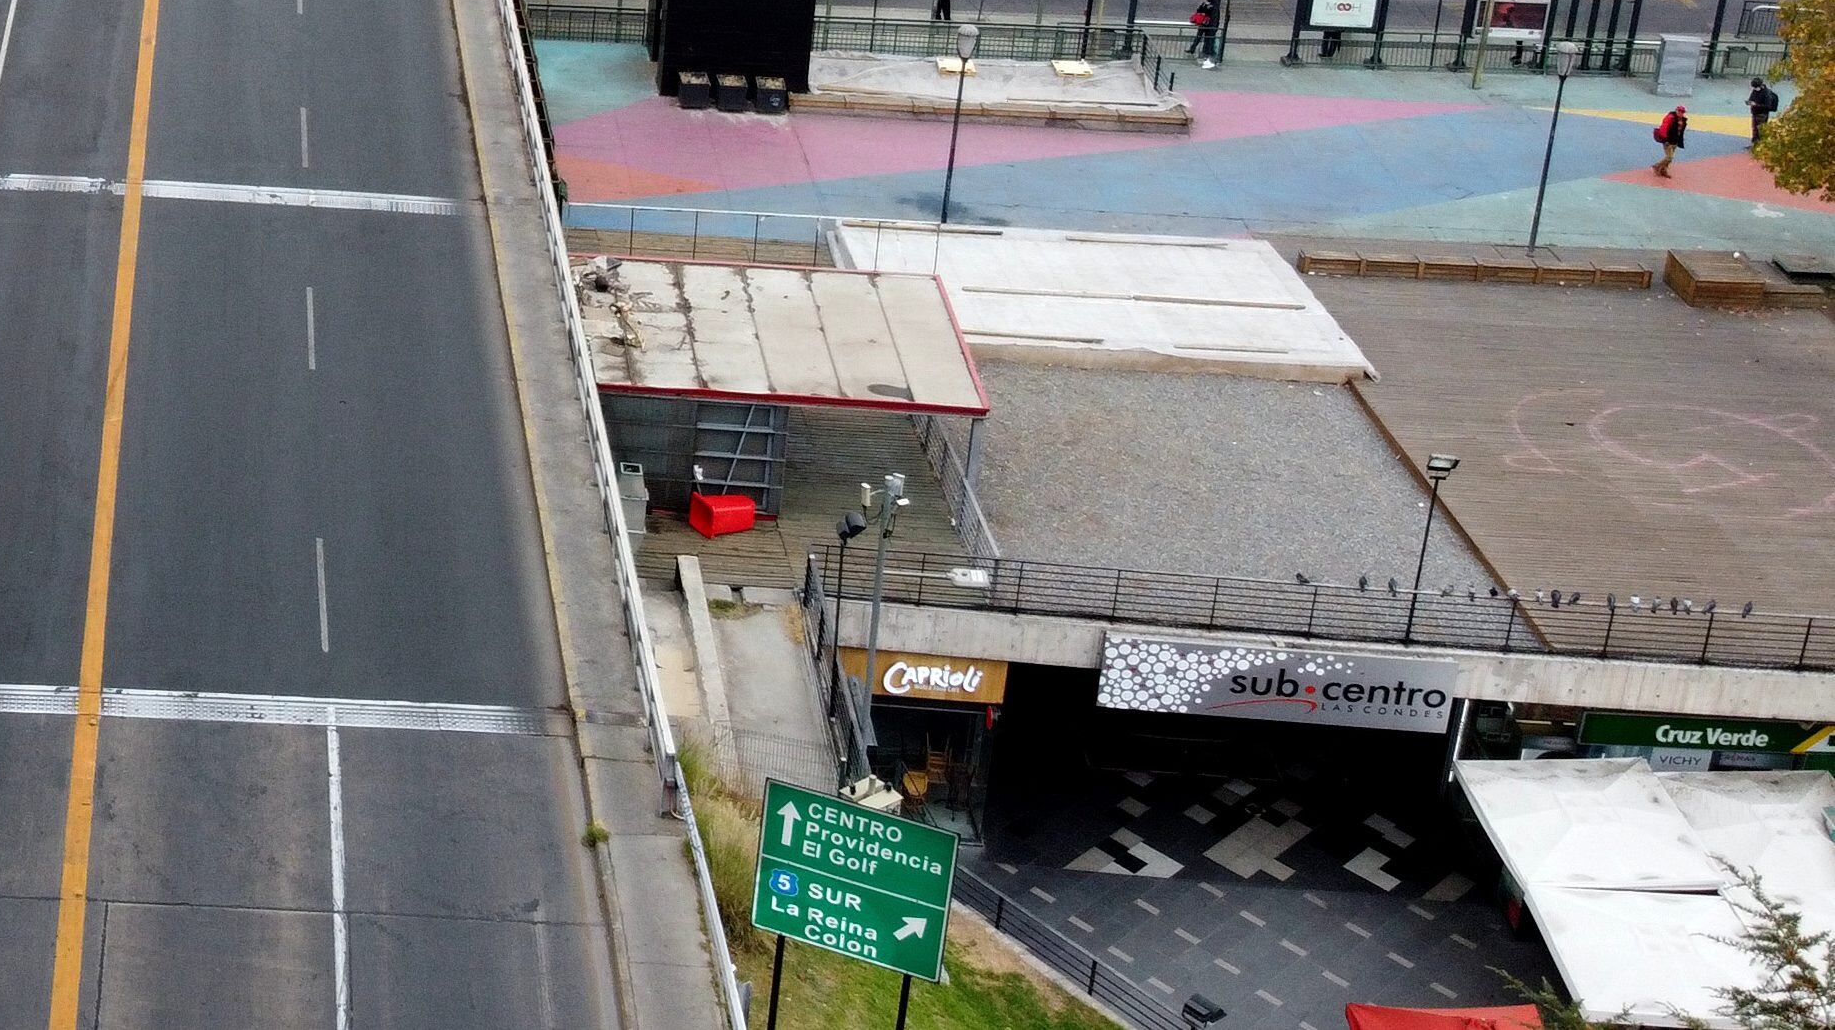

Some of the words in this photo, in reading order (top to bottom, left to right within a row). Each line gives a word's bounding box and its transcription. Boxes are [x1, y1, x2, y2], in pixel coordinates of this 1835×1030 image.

[1320, 702, 1354, 714] LAS
[1363, 705, 1445, 719] CONDES
[1655, 724, 1704, 744] Cruz
[1705, 727, 1769, 748] Verde
[1659, 755, 1702, 766] VICHY
[807, 802, 903, 843] CENTRO
[802, 840, 822, 859] El
[828, 849, 878, 875] Golf
[805, 821, 943, 876] Providencia
[776, 875, 791, 891] 5
[807, 883, 863, 911] SUR
[770, 896, 799, 917] La
[807, 908, 878, 941] Reina
[804, 924, 878, 958] Colon
